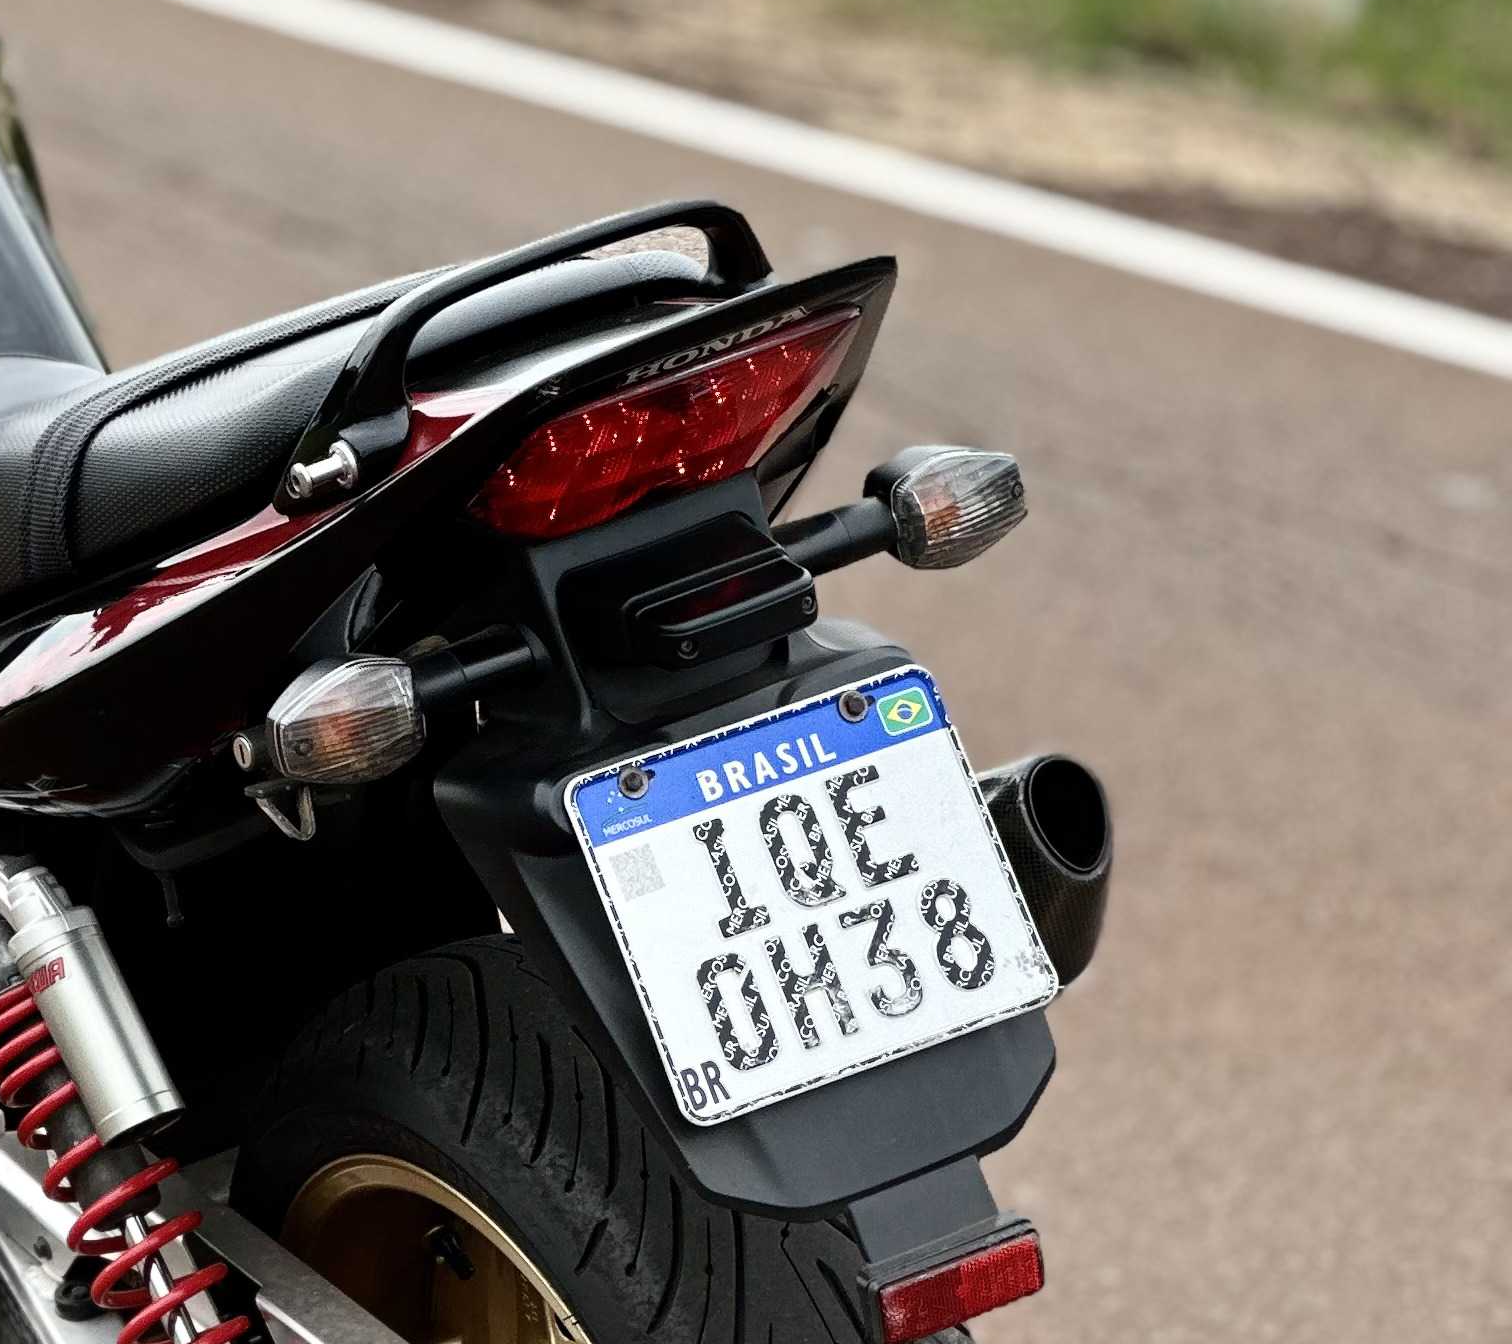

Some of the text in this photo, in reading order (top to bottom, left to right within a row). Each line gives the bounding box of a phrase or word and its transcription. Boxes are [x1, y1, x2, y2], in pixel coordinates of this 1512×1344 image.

[624, 306, 808, 384] HONDA
[695, 732, 837, 803] BRASIL
[602, 814, 653, 837] MERCOSUL
[692, 764, 920, 938] IQE
[681, 1061, 731, 1111] BR
